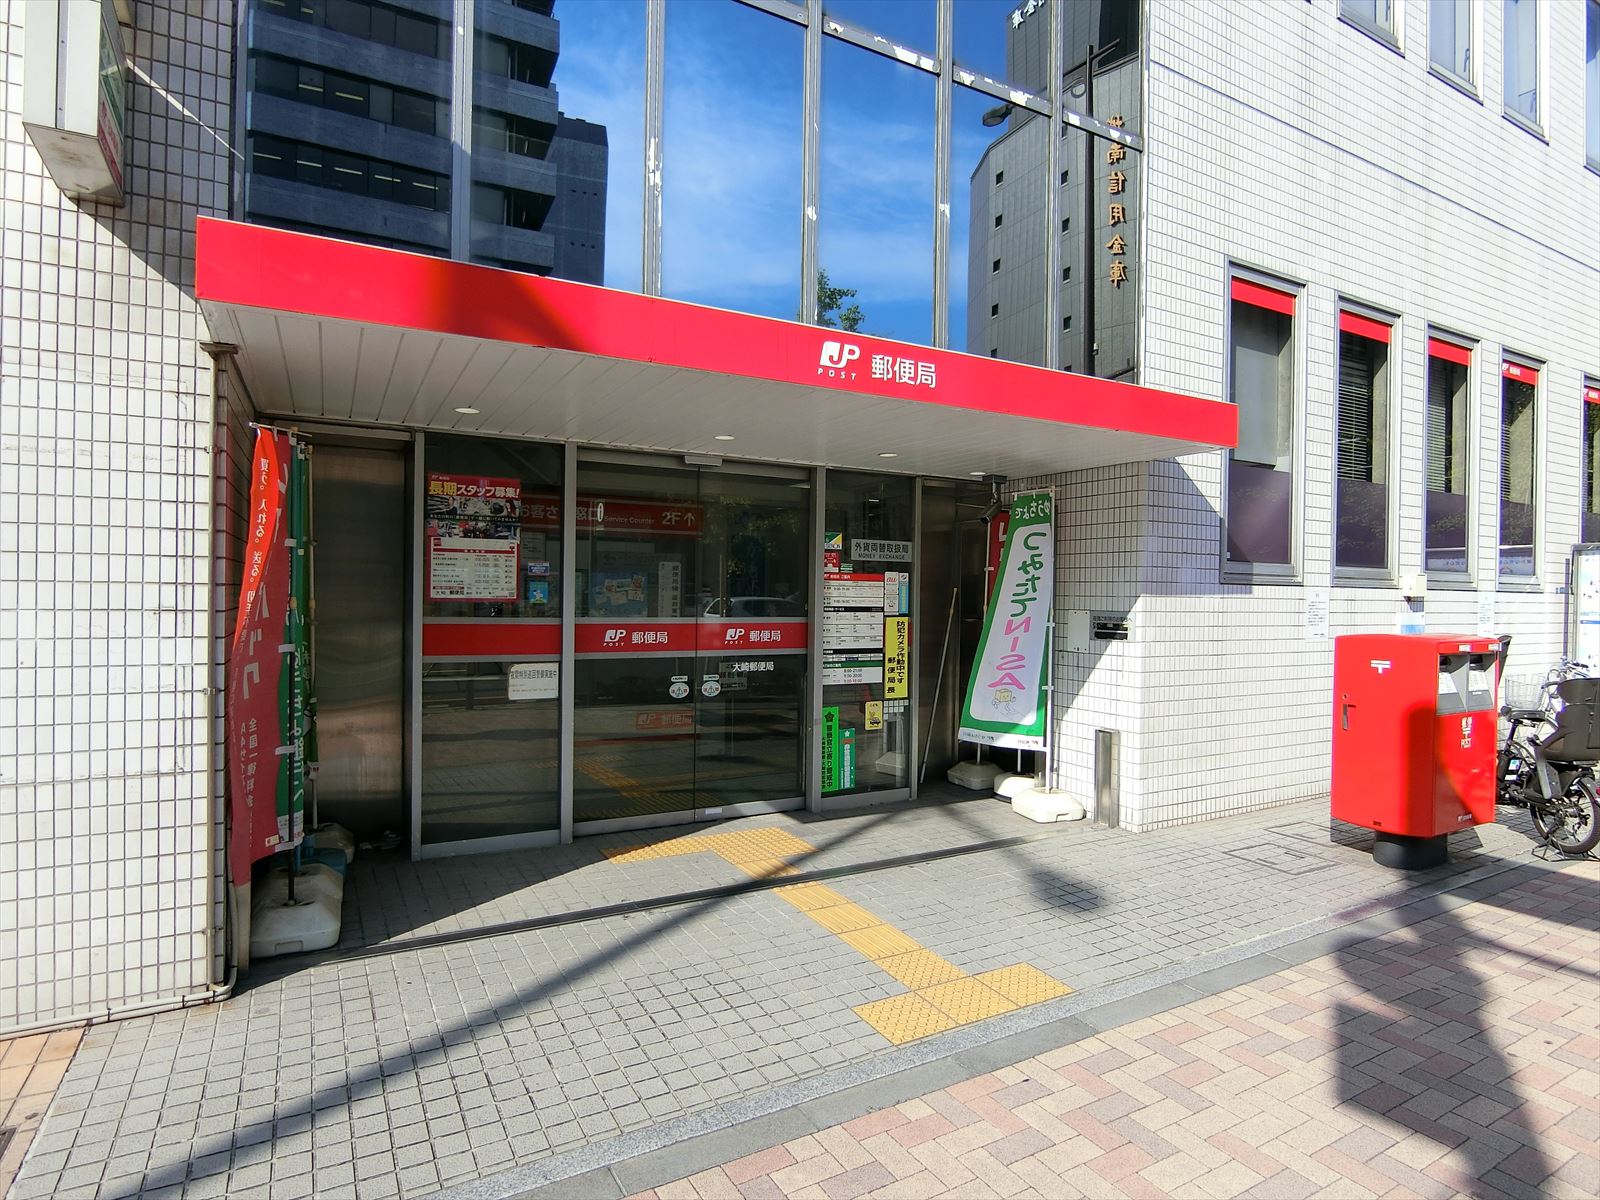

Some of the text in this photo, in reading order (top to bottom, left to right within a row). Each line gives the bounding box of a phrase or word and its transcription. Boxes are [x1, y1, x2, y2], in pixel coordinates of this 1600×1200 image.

[820, 341, 936, 388] JP 郵便局
[817, 367, 857, 380] POST
[662, 511, 682, 526] 2F
[632, 631, 668, 644] 郵便局
[749, 630, 781, 642] 郵便局
[732, 661, 774, 672] 大崎郵便局
[886, 656, 897, 694] 郵便局長
